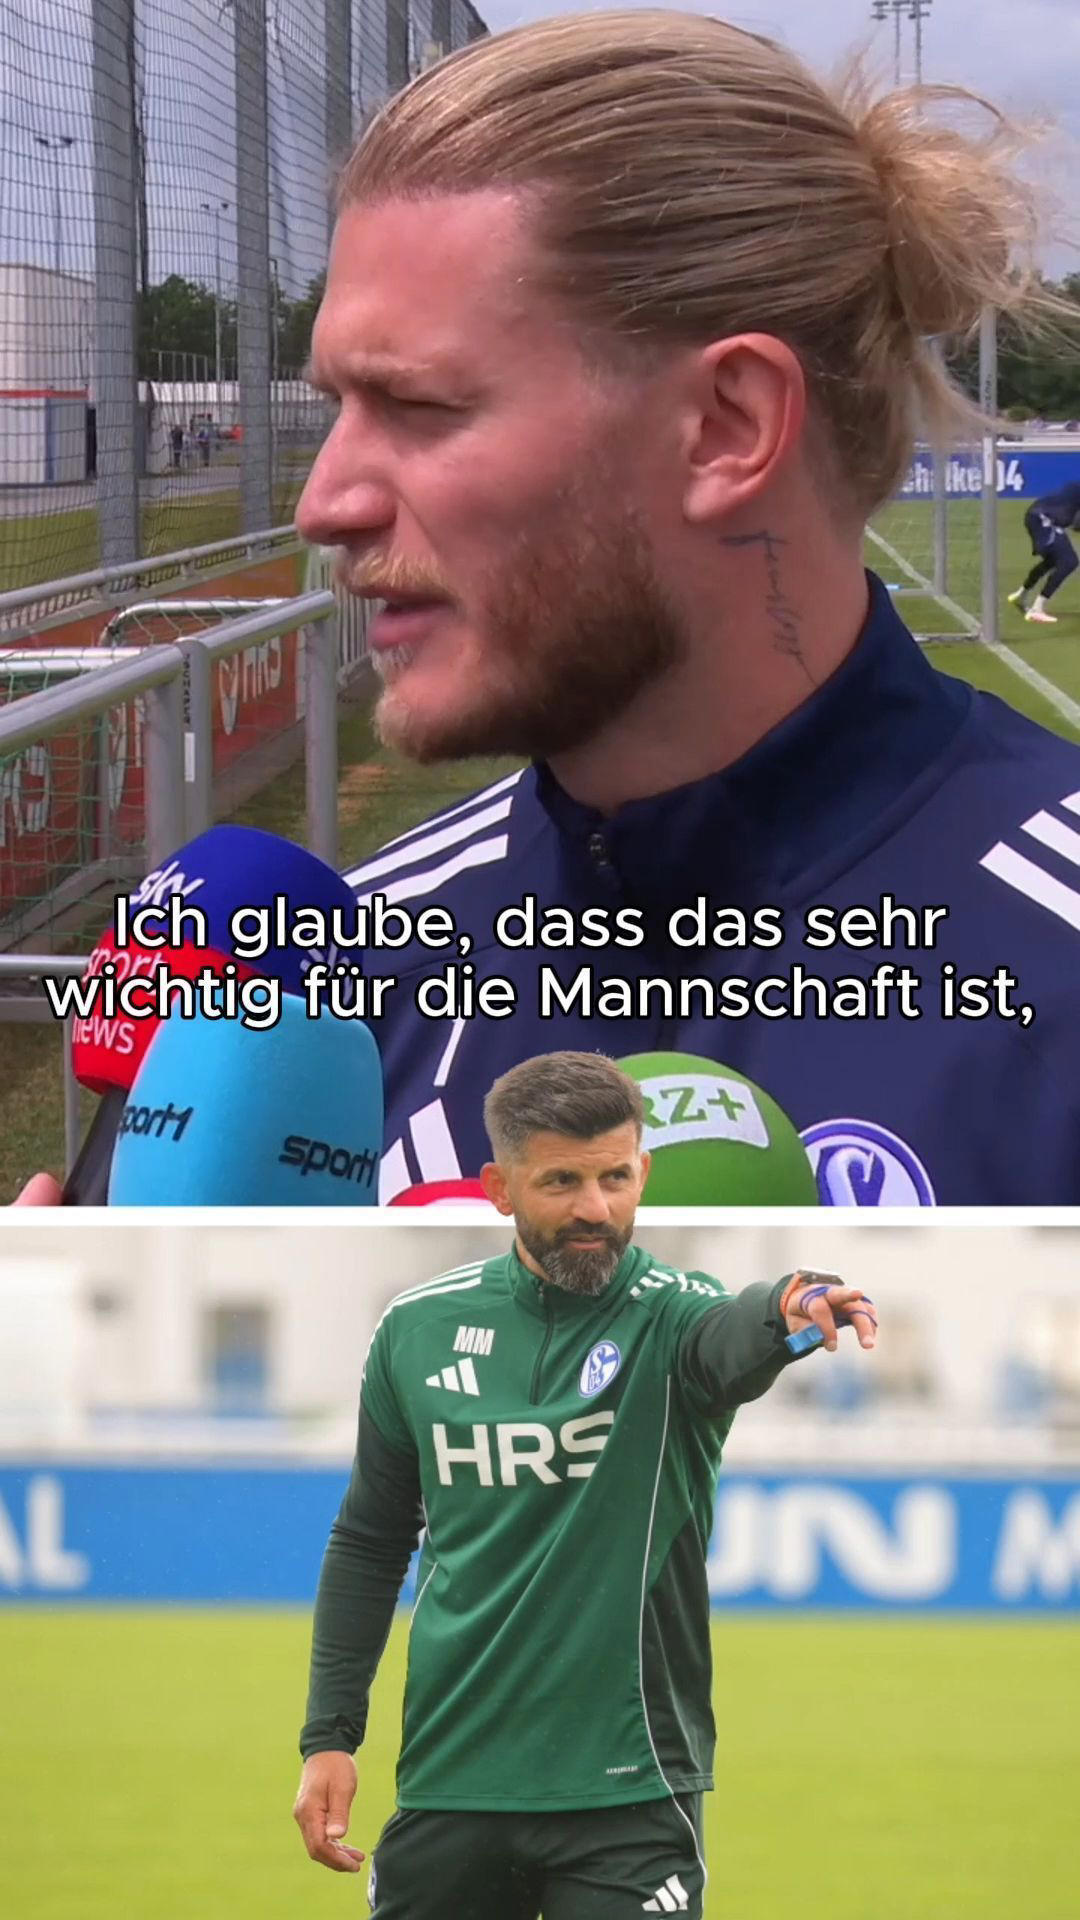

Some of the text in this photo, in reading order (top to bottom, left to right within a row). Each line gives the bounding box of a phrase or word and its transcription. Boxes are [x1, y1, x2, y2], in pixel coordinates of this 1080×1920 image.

[72, 1012, 136, 1055] news
[453, 1325, 495, 1356] MM
[432, 1410, 615, 1487] HRS
